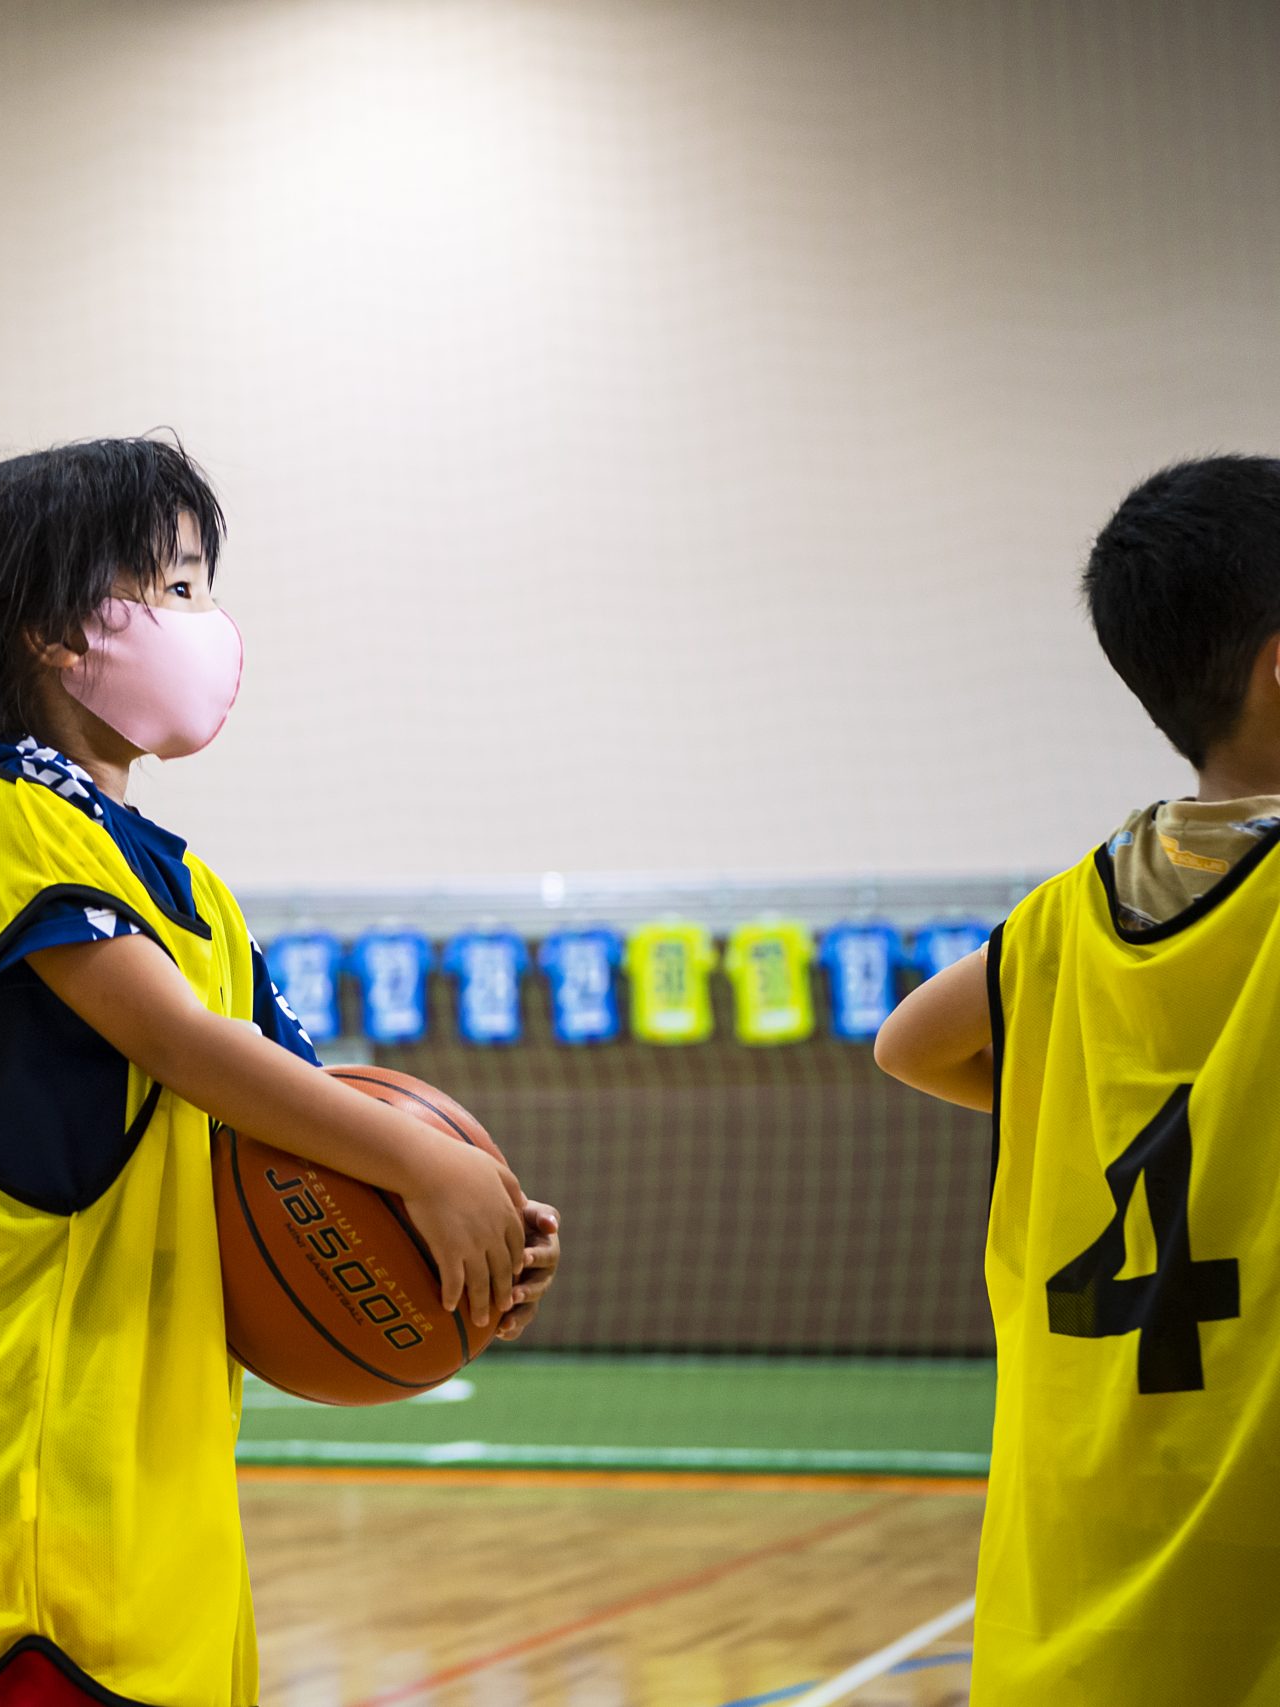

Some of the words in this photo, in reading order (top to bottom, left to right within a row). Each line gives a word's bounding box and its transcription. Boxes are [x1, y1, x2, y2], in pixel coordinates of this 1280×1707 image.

[264, 1168, 424, 1350] JB5000
[297, 1163, 362, 1245] REMIUM
[365, 1257, 433, 1332] LEATHER
[1046, 1083, 1239, 1394] 4
